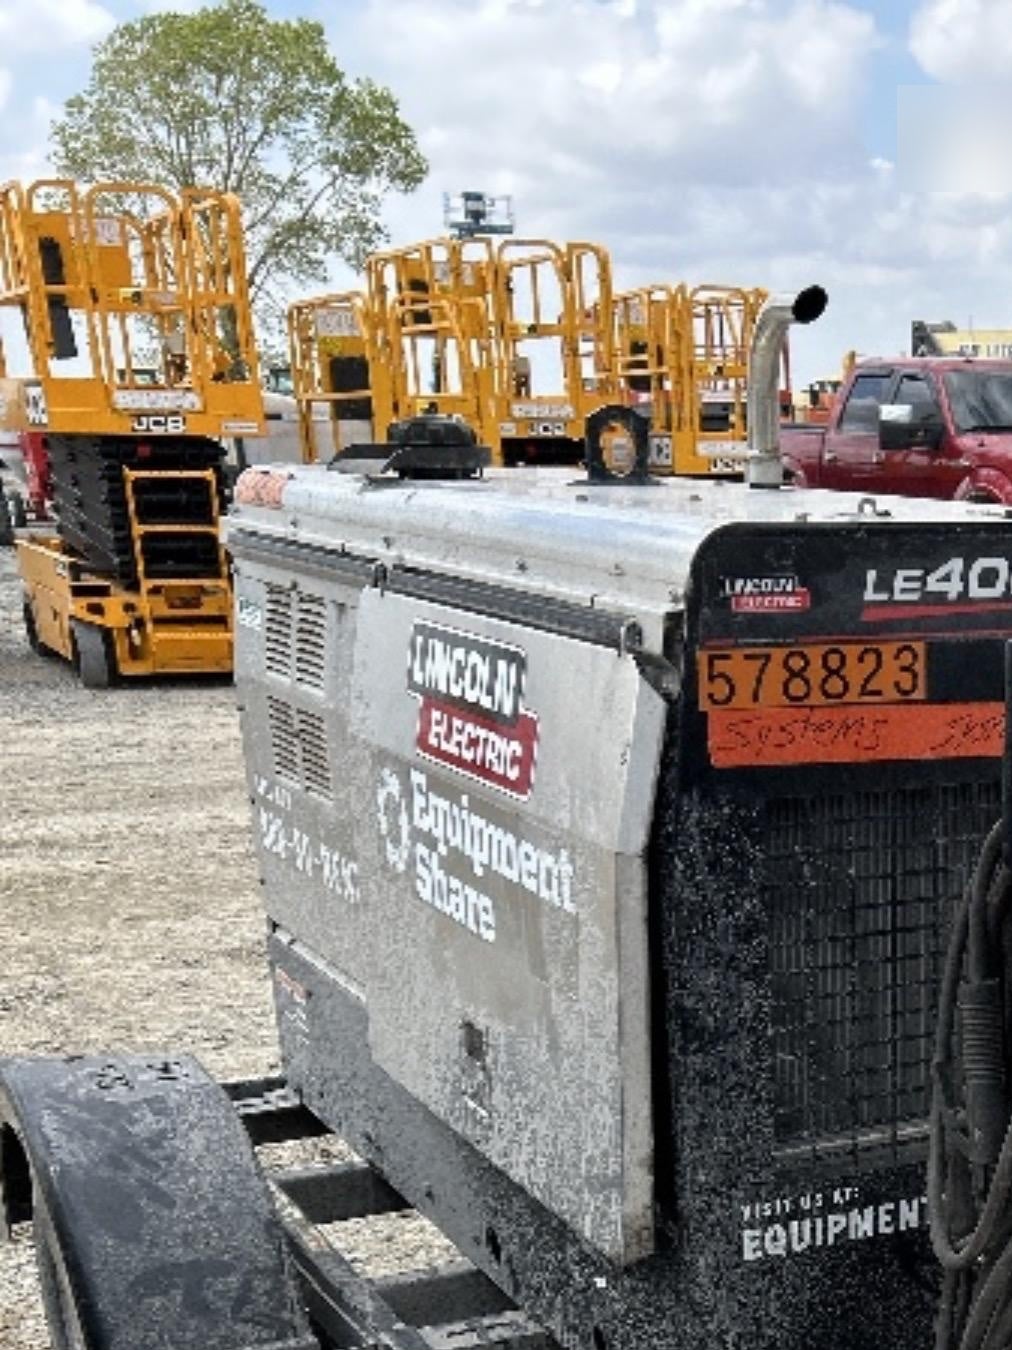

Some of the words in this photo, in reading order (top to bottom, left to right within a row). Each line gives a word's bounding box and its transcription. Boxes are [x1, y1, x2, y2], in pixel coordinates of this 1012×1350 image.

[133, 416, 186, 432] JCB
[412, 634, 517, 717] LINCOLN
[706, 644, 920, 706] 578823
[427, 707, 524, 781] ELECTRIC
[410, 766, 578, 914] Equipment
[414, 841, 497, 943] Share
[740, 1197, 791, 1221] VISIT
[800, 1193, 823, 1210] US
[832, 1187, 859, 1205] AT:
